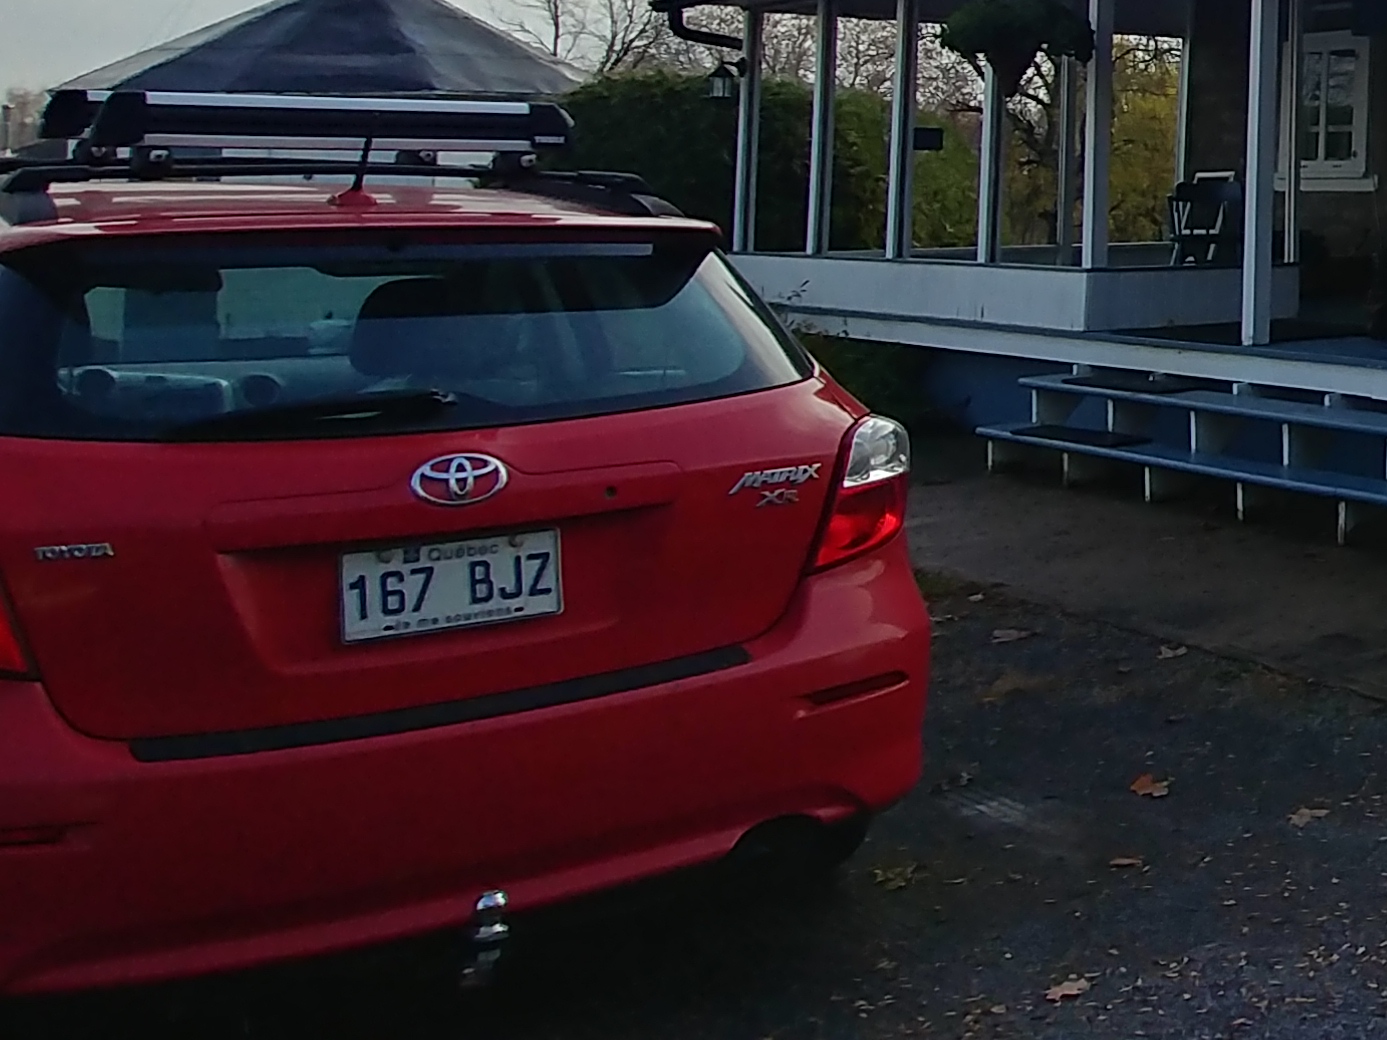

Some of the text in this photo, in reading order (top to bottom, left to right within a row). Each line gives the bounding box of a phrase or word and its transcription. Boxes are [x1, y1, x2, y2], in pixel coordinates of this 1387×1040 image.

[728, 462, 822, 495] MATRIX
[349, 552, 553, 621] 167 BJZ
